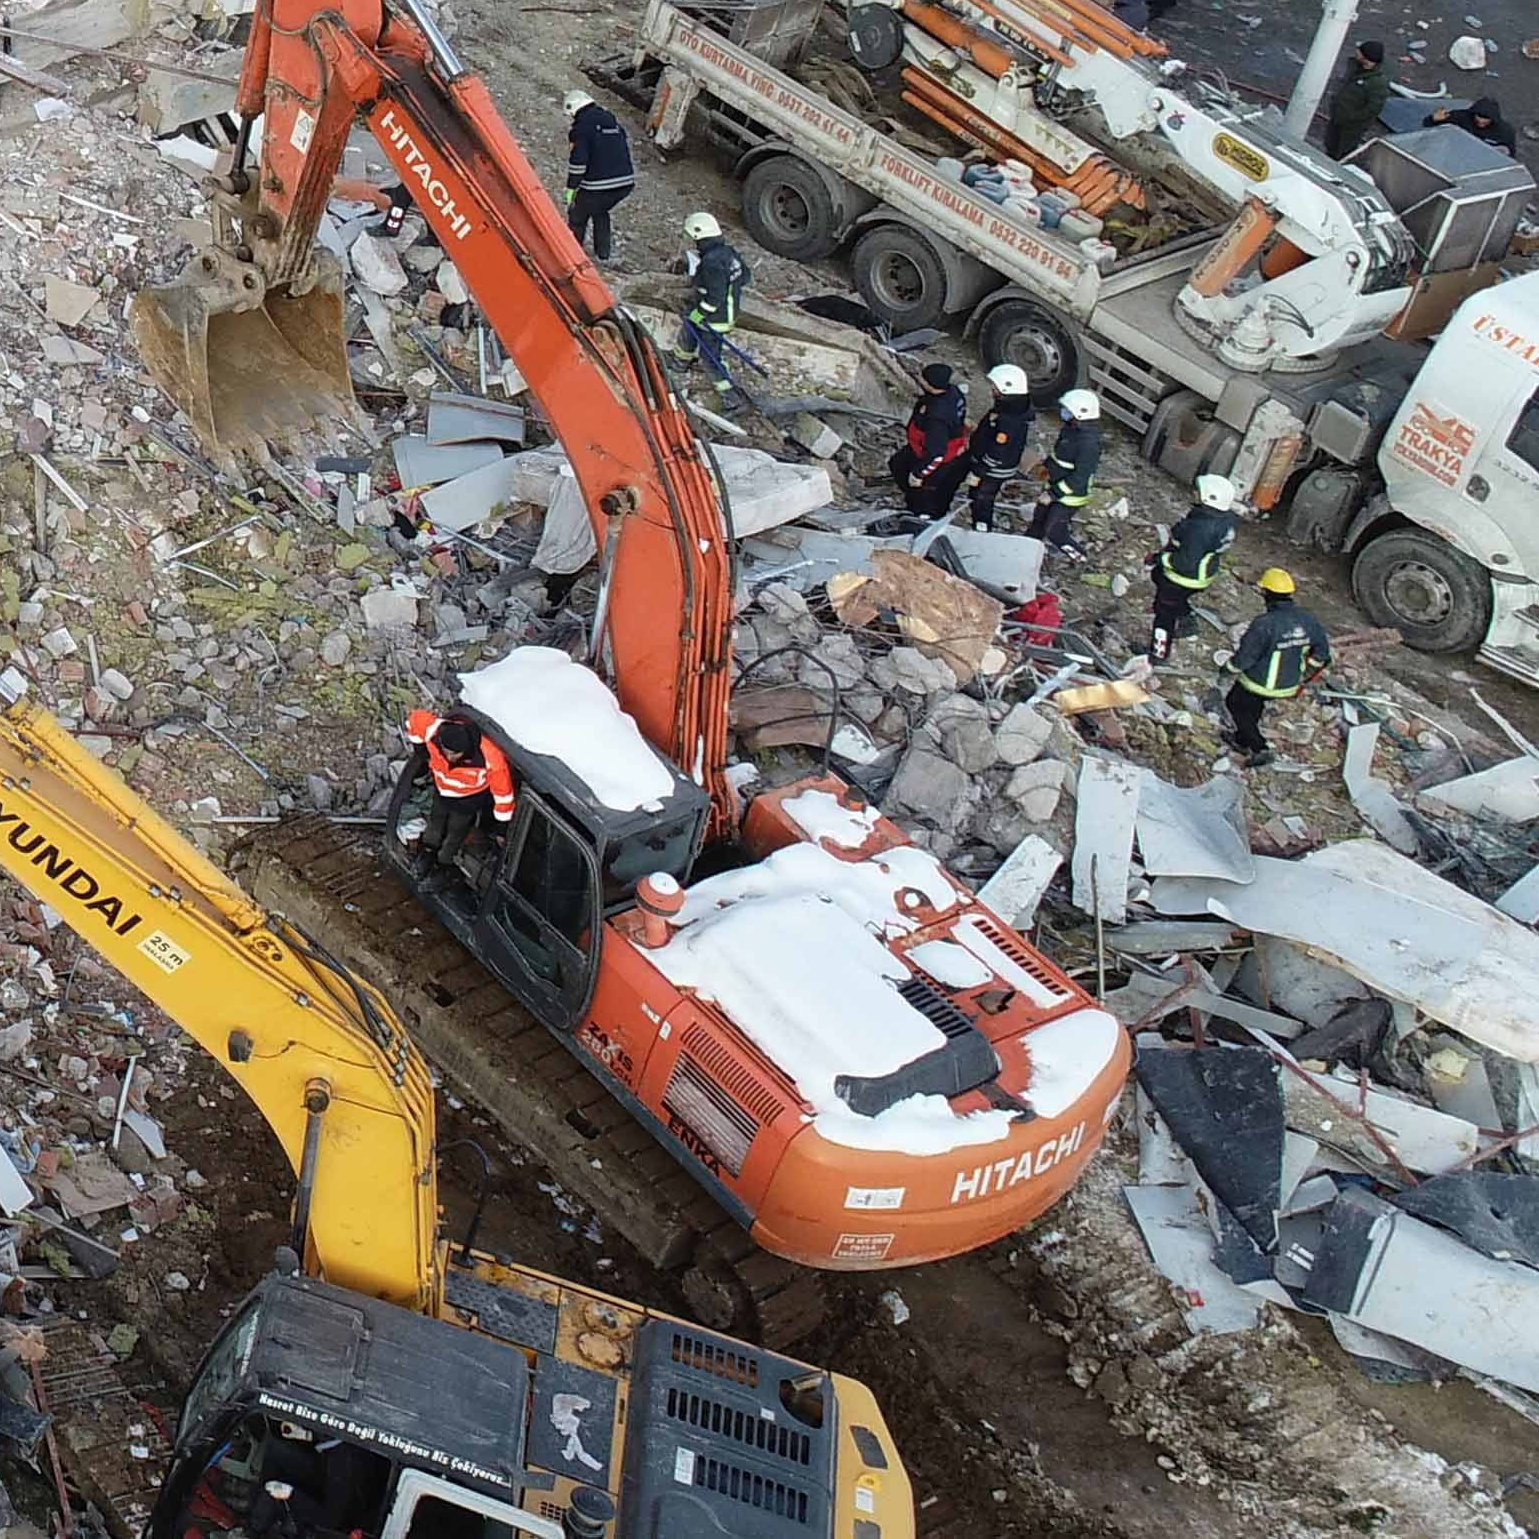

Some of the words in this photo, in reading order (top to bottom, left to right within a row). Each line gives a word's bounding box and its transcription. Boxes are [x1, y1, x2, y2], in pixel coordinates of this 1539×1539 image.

[679, 30, 699, 50] OTO
[380, 110, 472, 240] HITACHI
[989, 220, 1015, 246] 0532
[1400, 424, 1462, 475] TRAKYA
[149, 935, 171, 953] 25
[588, 1020, 635, 1073] ZAXIS
[668, 1114, 724, 1177] ENKA
[950, 1120, 1086, 1204] HITACHI
[295, 1403, 319, 1421] Bize
[320, 1412, 346, 1431] Göre
[347, 1422, 376, 1440] Değil
[431, 1448, 449, 1466] Biz
